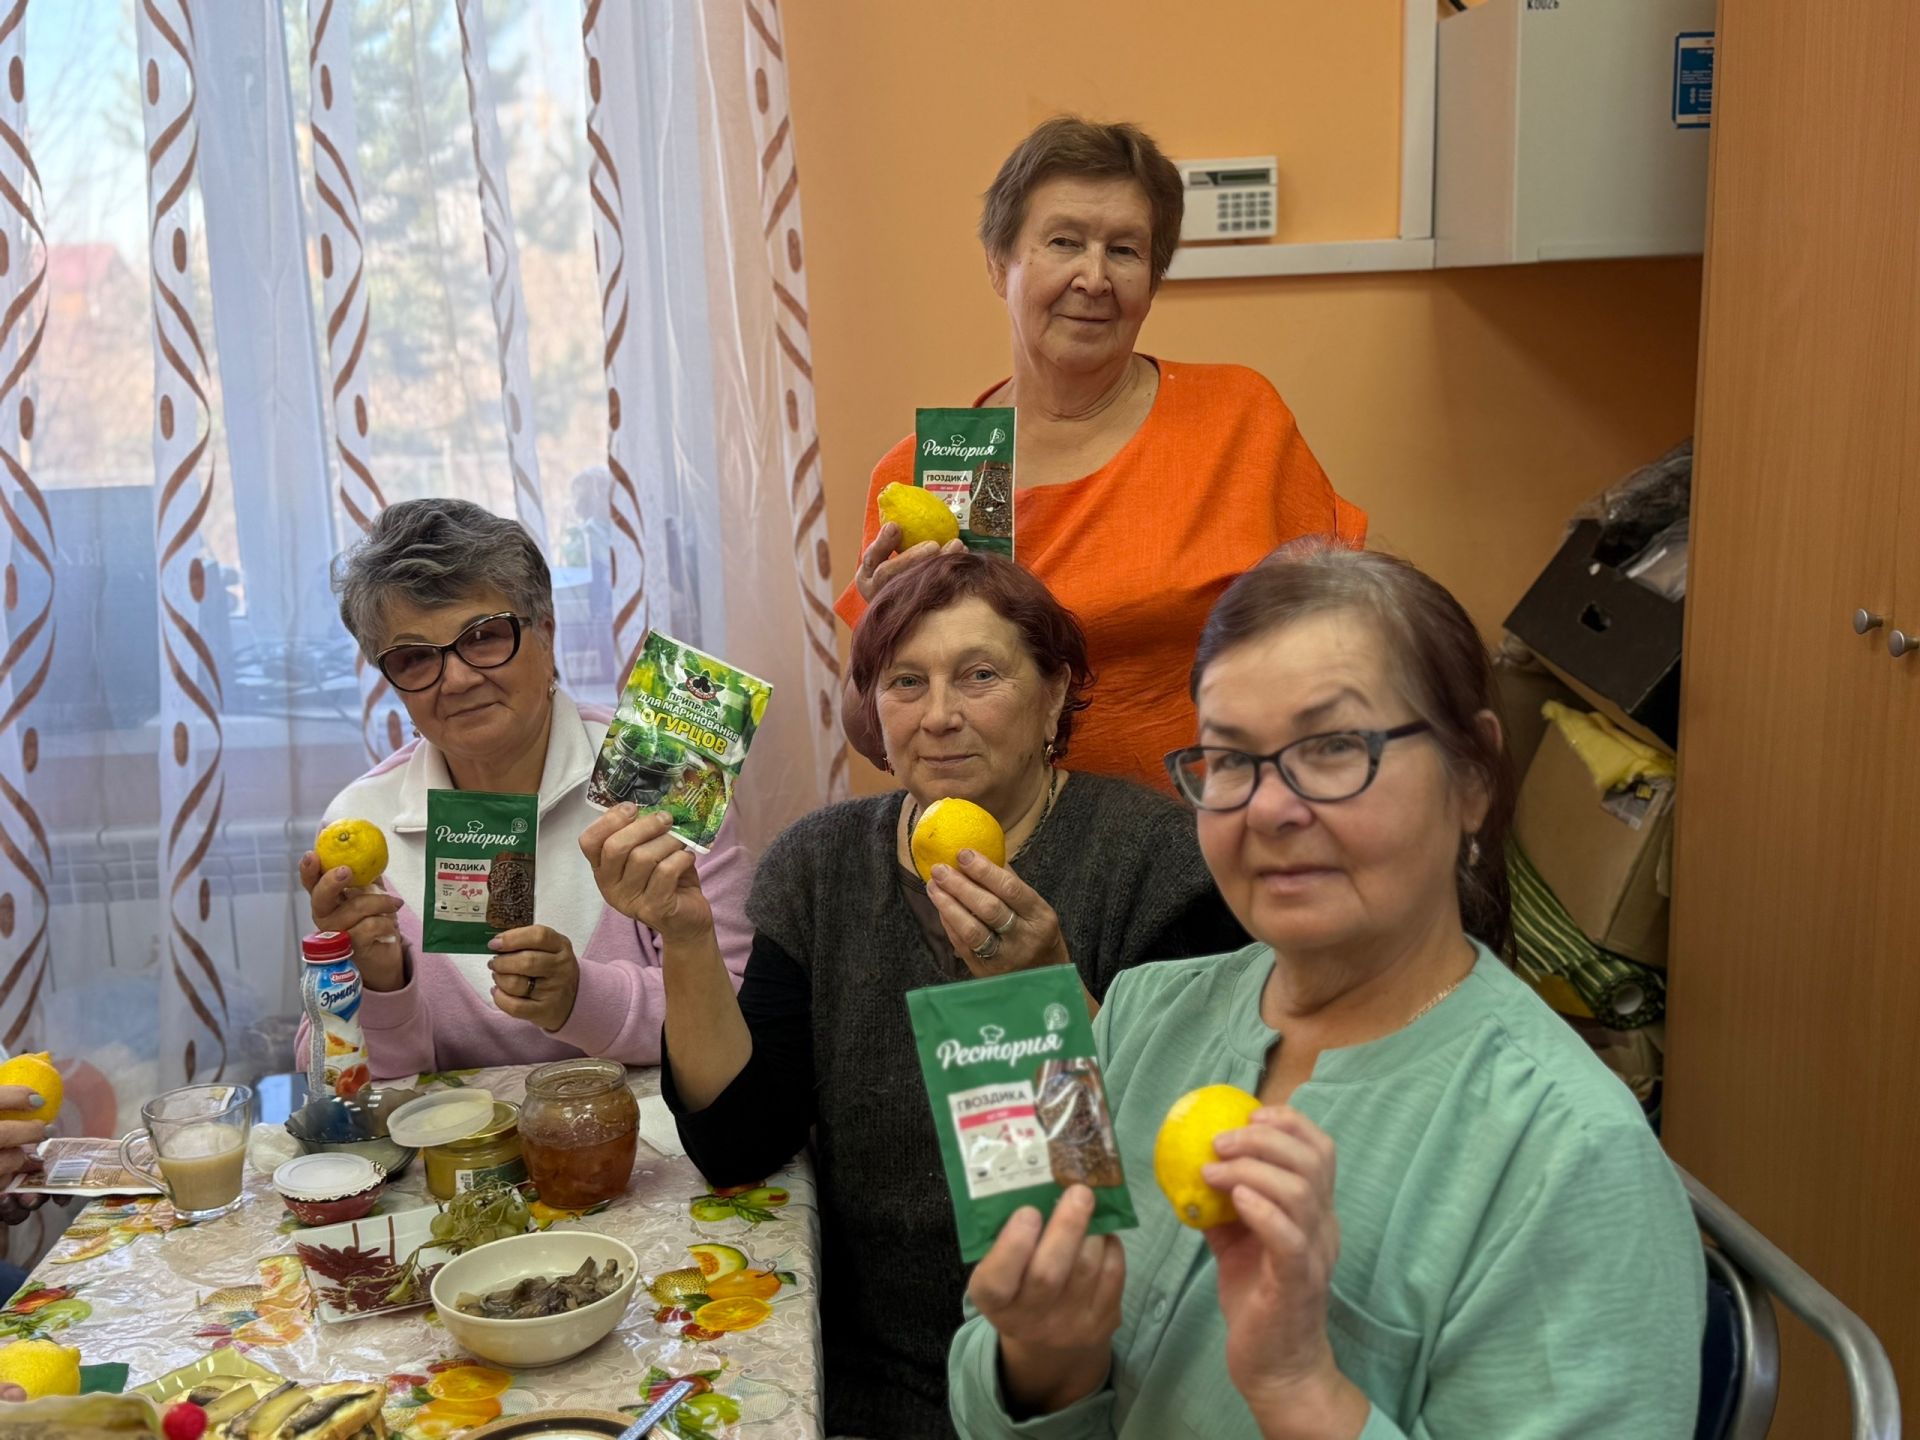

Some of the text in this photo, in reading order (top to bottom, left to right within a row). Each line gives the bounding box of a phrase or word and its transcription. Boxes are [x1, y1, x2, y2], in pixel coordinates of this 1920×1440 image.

[922, 439, 997, 462] Рестория
[926, 474, 969, 482] ГВОЗДИКА
[638, 693, 740, 743] ДЛЯ МАРИНОВАНИЯ
[668, 692, 719, 719] ПРИПРАВА
[641, 707, 728, 755] ОГУРЦОВ
[435, 825, 520, 850] Рестория
[440, 862, 486, 872] ГВОЗДИКА
[936, 1032, 1063, 1070] Рестория
[957, 1091, 1027, 1112] ГВОЗДИКА
